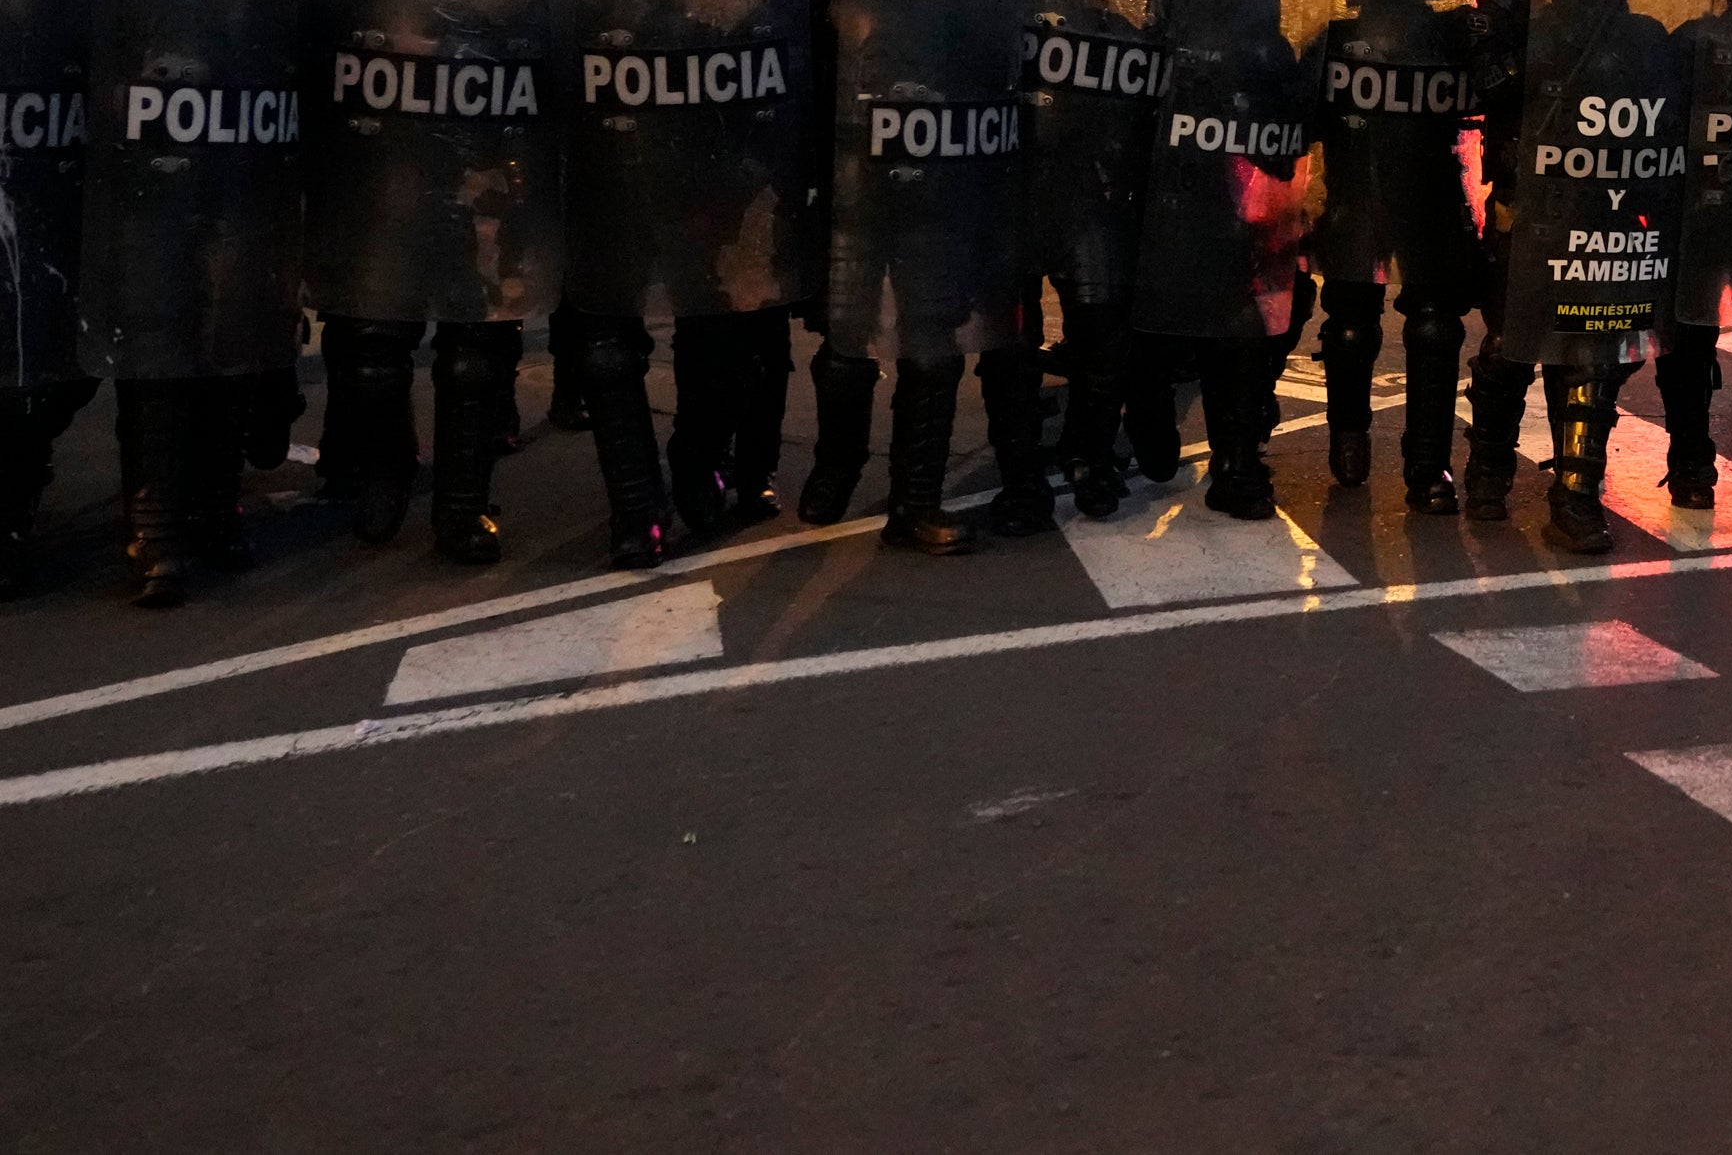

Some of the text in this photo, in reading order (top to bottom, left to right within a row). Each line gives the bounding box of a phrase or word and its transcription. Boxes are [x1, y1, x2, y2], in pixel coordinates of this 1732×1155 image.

[333, 52, 538, 117] POLICIA
[584, 48, 787, 106] POLICIA
[126, 86, 300, 143] POLICIA
[871, 104, 1021, 158] POLICIA
[1577, 96, 1666, 138] SOY
[1169, 113, 1303, 156] POLICIA
[1535, 145, 1686, 179] POLICIA
[1607, 189, 1626, 211] Y
[1568, 230, 1660, 253] PADRE
[1547, 255, 1669, 281] TAMBIÉN
[1557, 302, 1653, 316] MANIFIÉSTATE
[1585, 319, 1633, 331] EN PAZ
